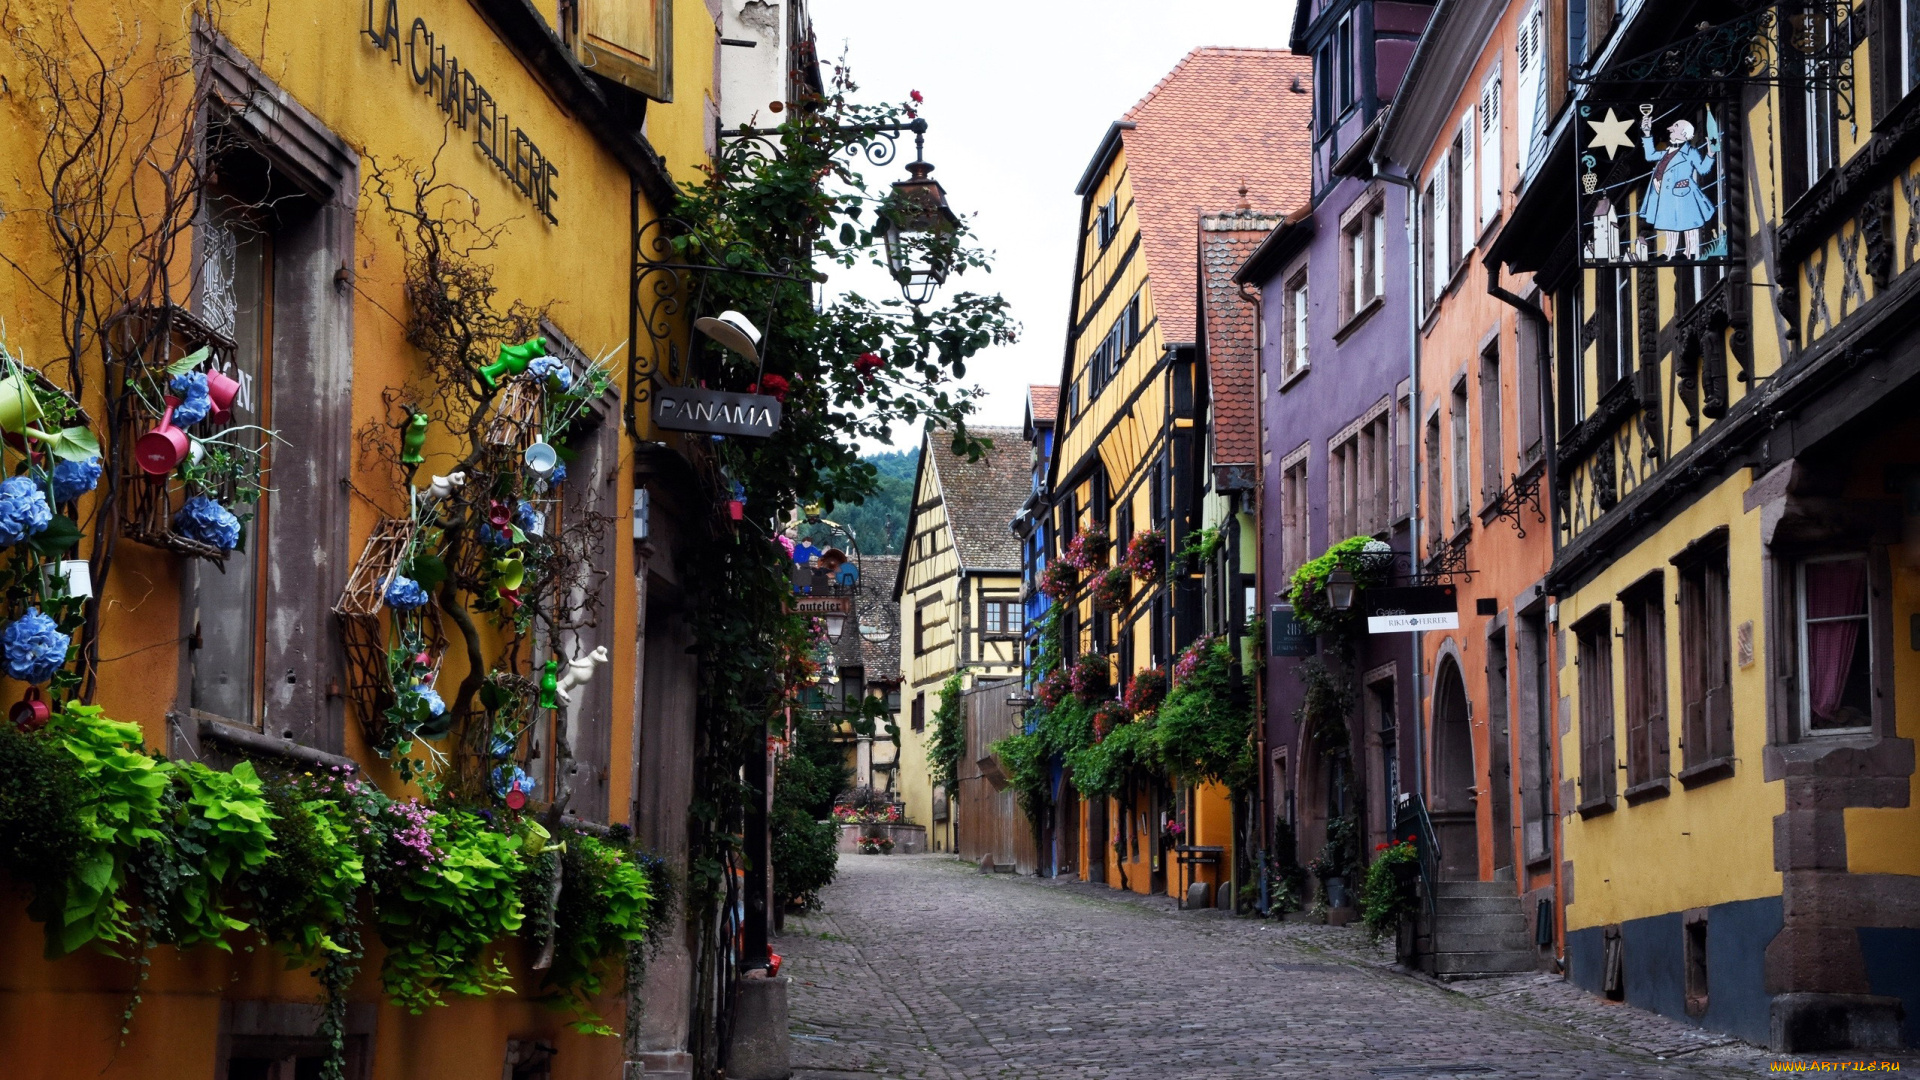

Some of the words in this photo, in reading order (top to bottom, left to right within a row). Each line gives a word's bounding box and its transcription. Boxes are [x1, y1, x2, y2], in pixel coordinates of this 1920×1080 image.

[368, 0, 401, 66] LA
[410, 17, 559, 227] CHAPELLERIE
[659, 396, 773, 428] PANAMA
[1376, 607, 1407, 617] Galerie
